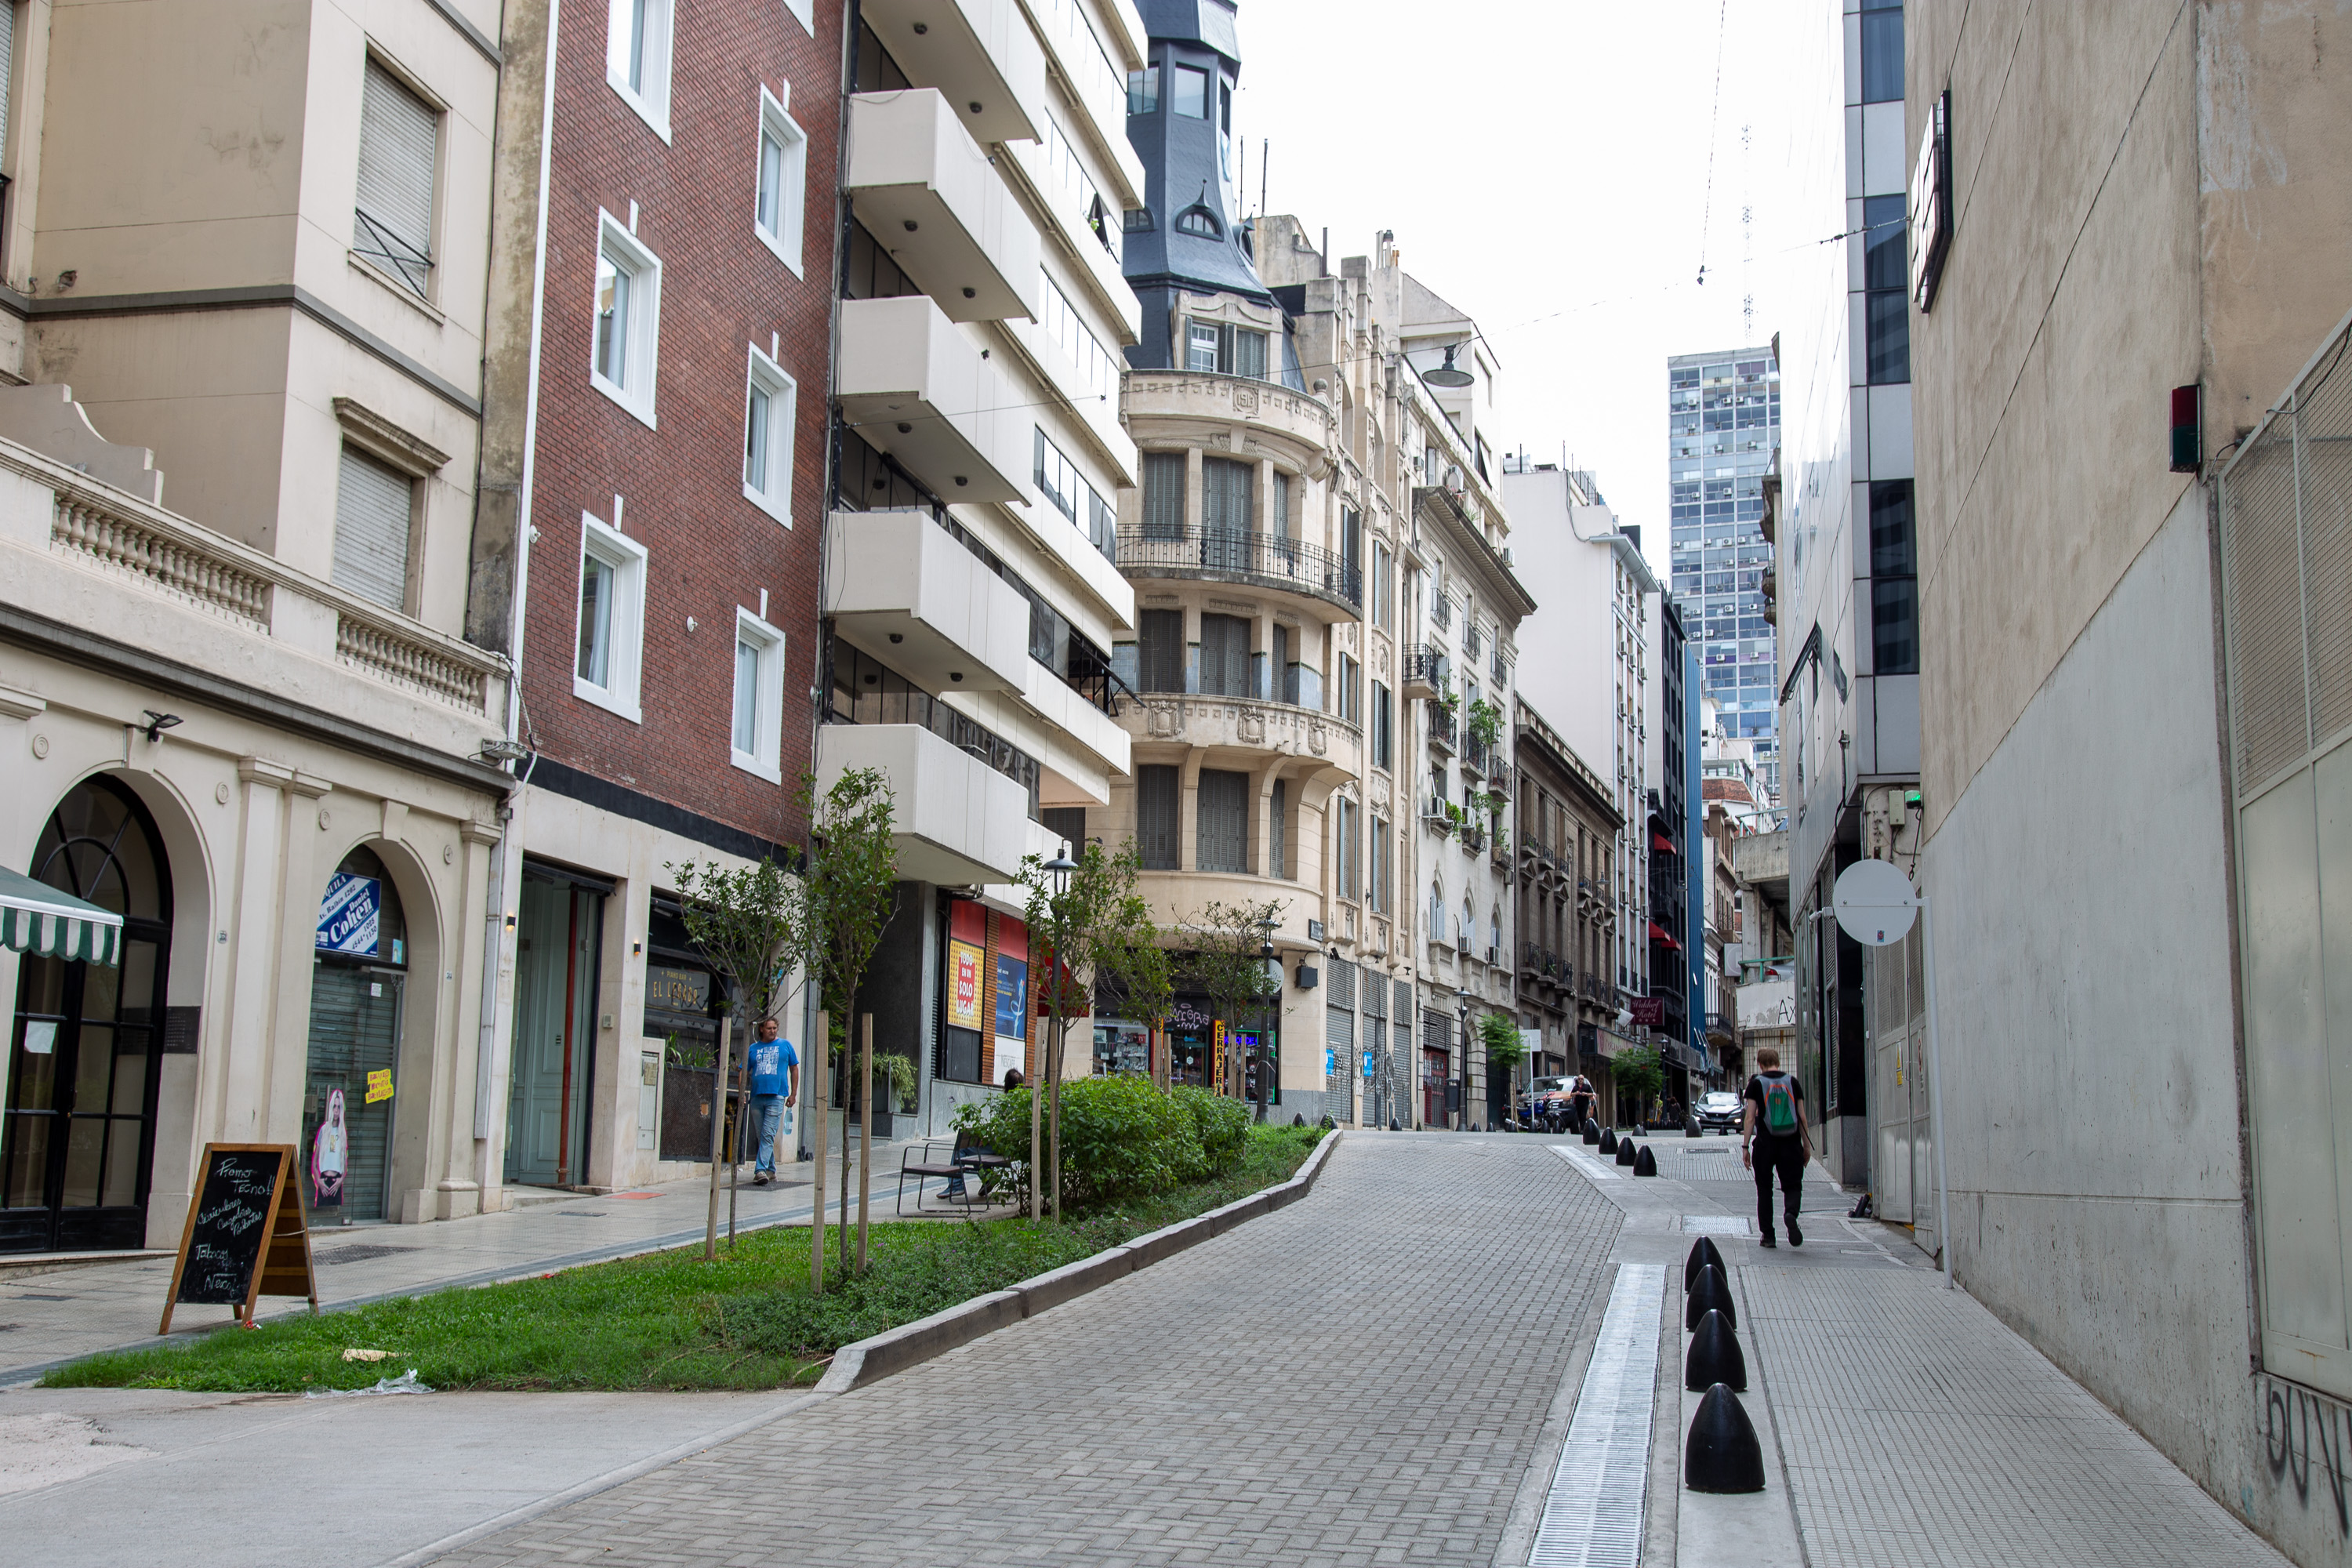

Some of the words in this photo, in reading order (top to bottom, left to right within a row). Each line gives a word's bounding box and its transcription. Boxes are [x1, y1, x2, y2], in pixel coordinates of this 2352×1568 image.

[349, 888, 370, 912] Daniel
[330, 898, 374, 943] Cohen
[960, 951, 974, 967] TODO
[666, 971, 678, 979] PIANO
[961, 967, 966, 977] EN
[967, 968, 971, 978] UN
[653, 982, 662, 997] EL
[959, 980, 973, 997] SOLO
[956, 999, 974, 1016] LUGAR
[1632, 999, 1661, 1011] Waldorf
[1637, 1009, 1657, 1018] Hotel
